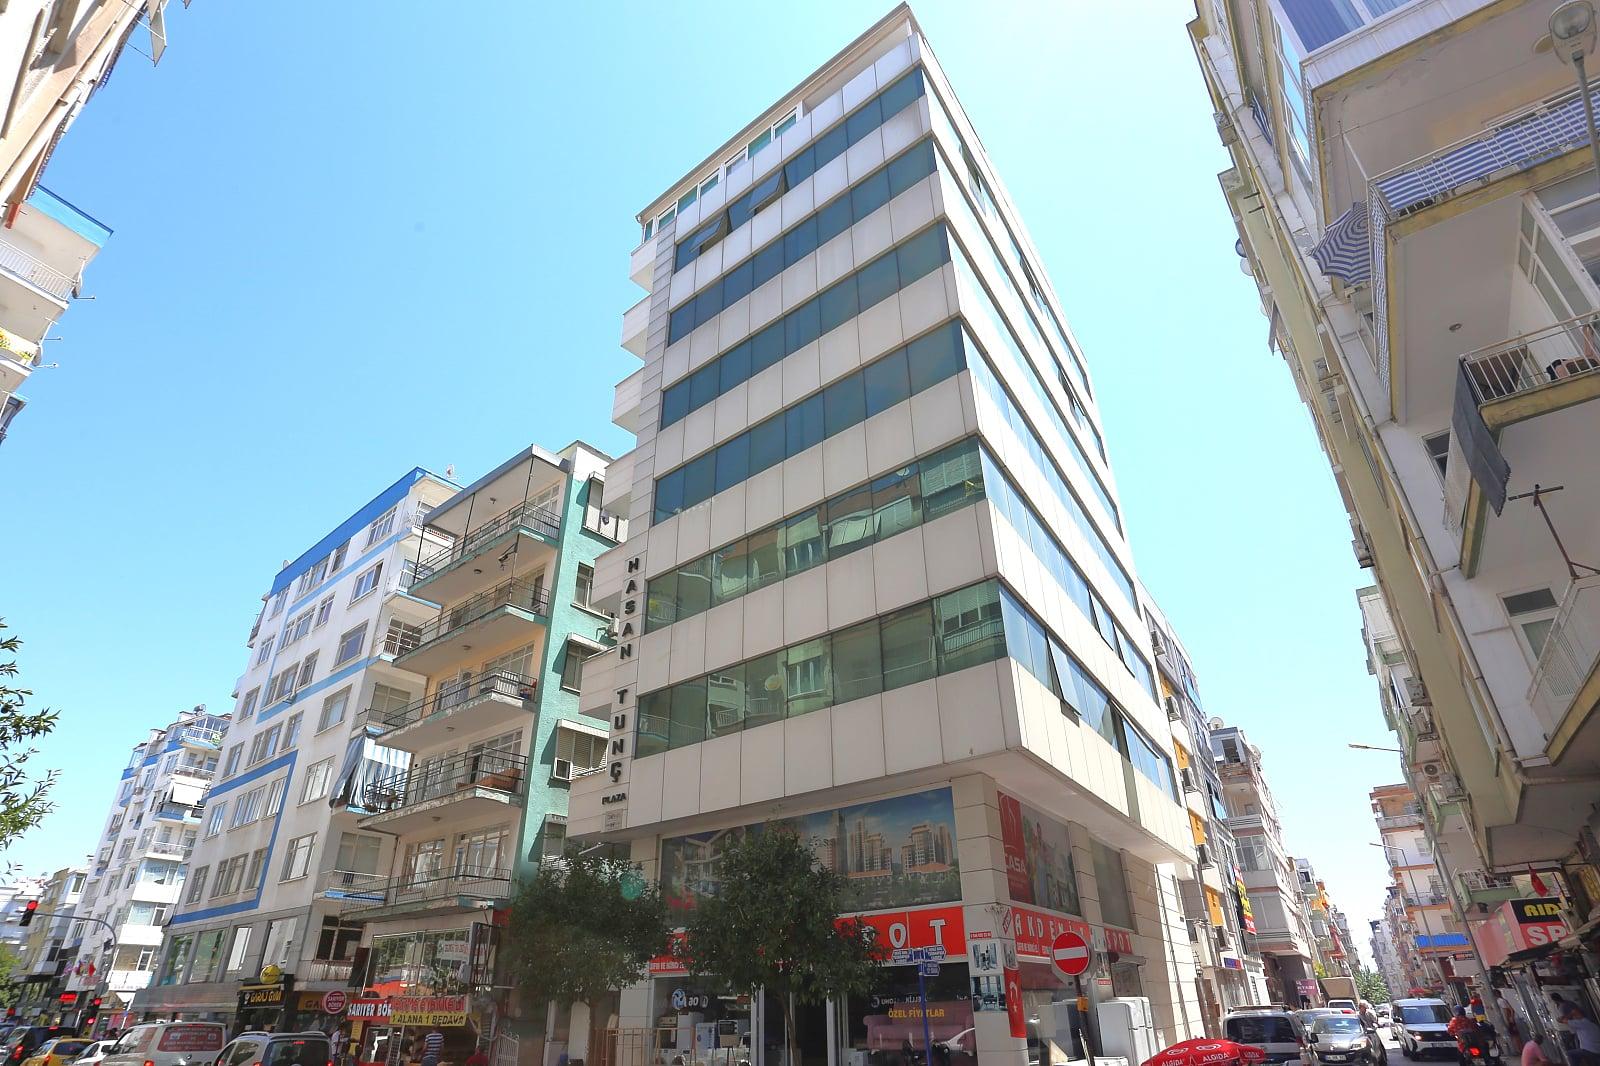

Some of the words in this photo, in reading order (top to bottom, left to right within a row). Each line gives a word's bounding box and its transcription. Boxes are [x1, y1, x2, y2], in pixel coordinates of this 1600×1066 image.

[620, 557, 640, 660] HASAN
[610, 689, 628, 783] TUNÇ
[601, 792, 627, 805] PLAZA
[1527, 925, 1567, 946] SP
[377, 1000, 392, 1017] BÖR
[888, 1008, 907, 1018] ÖZEL
[397, 1014, 423, 1024] ALANA
[431, 1015, 464, 1025] BEDAVA
[1203, 1052, 1229, 1062] ALGIDA
